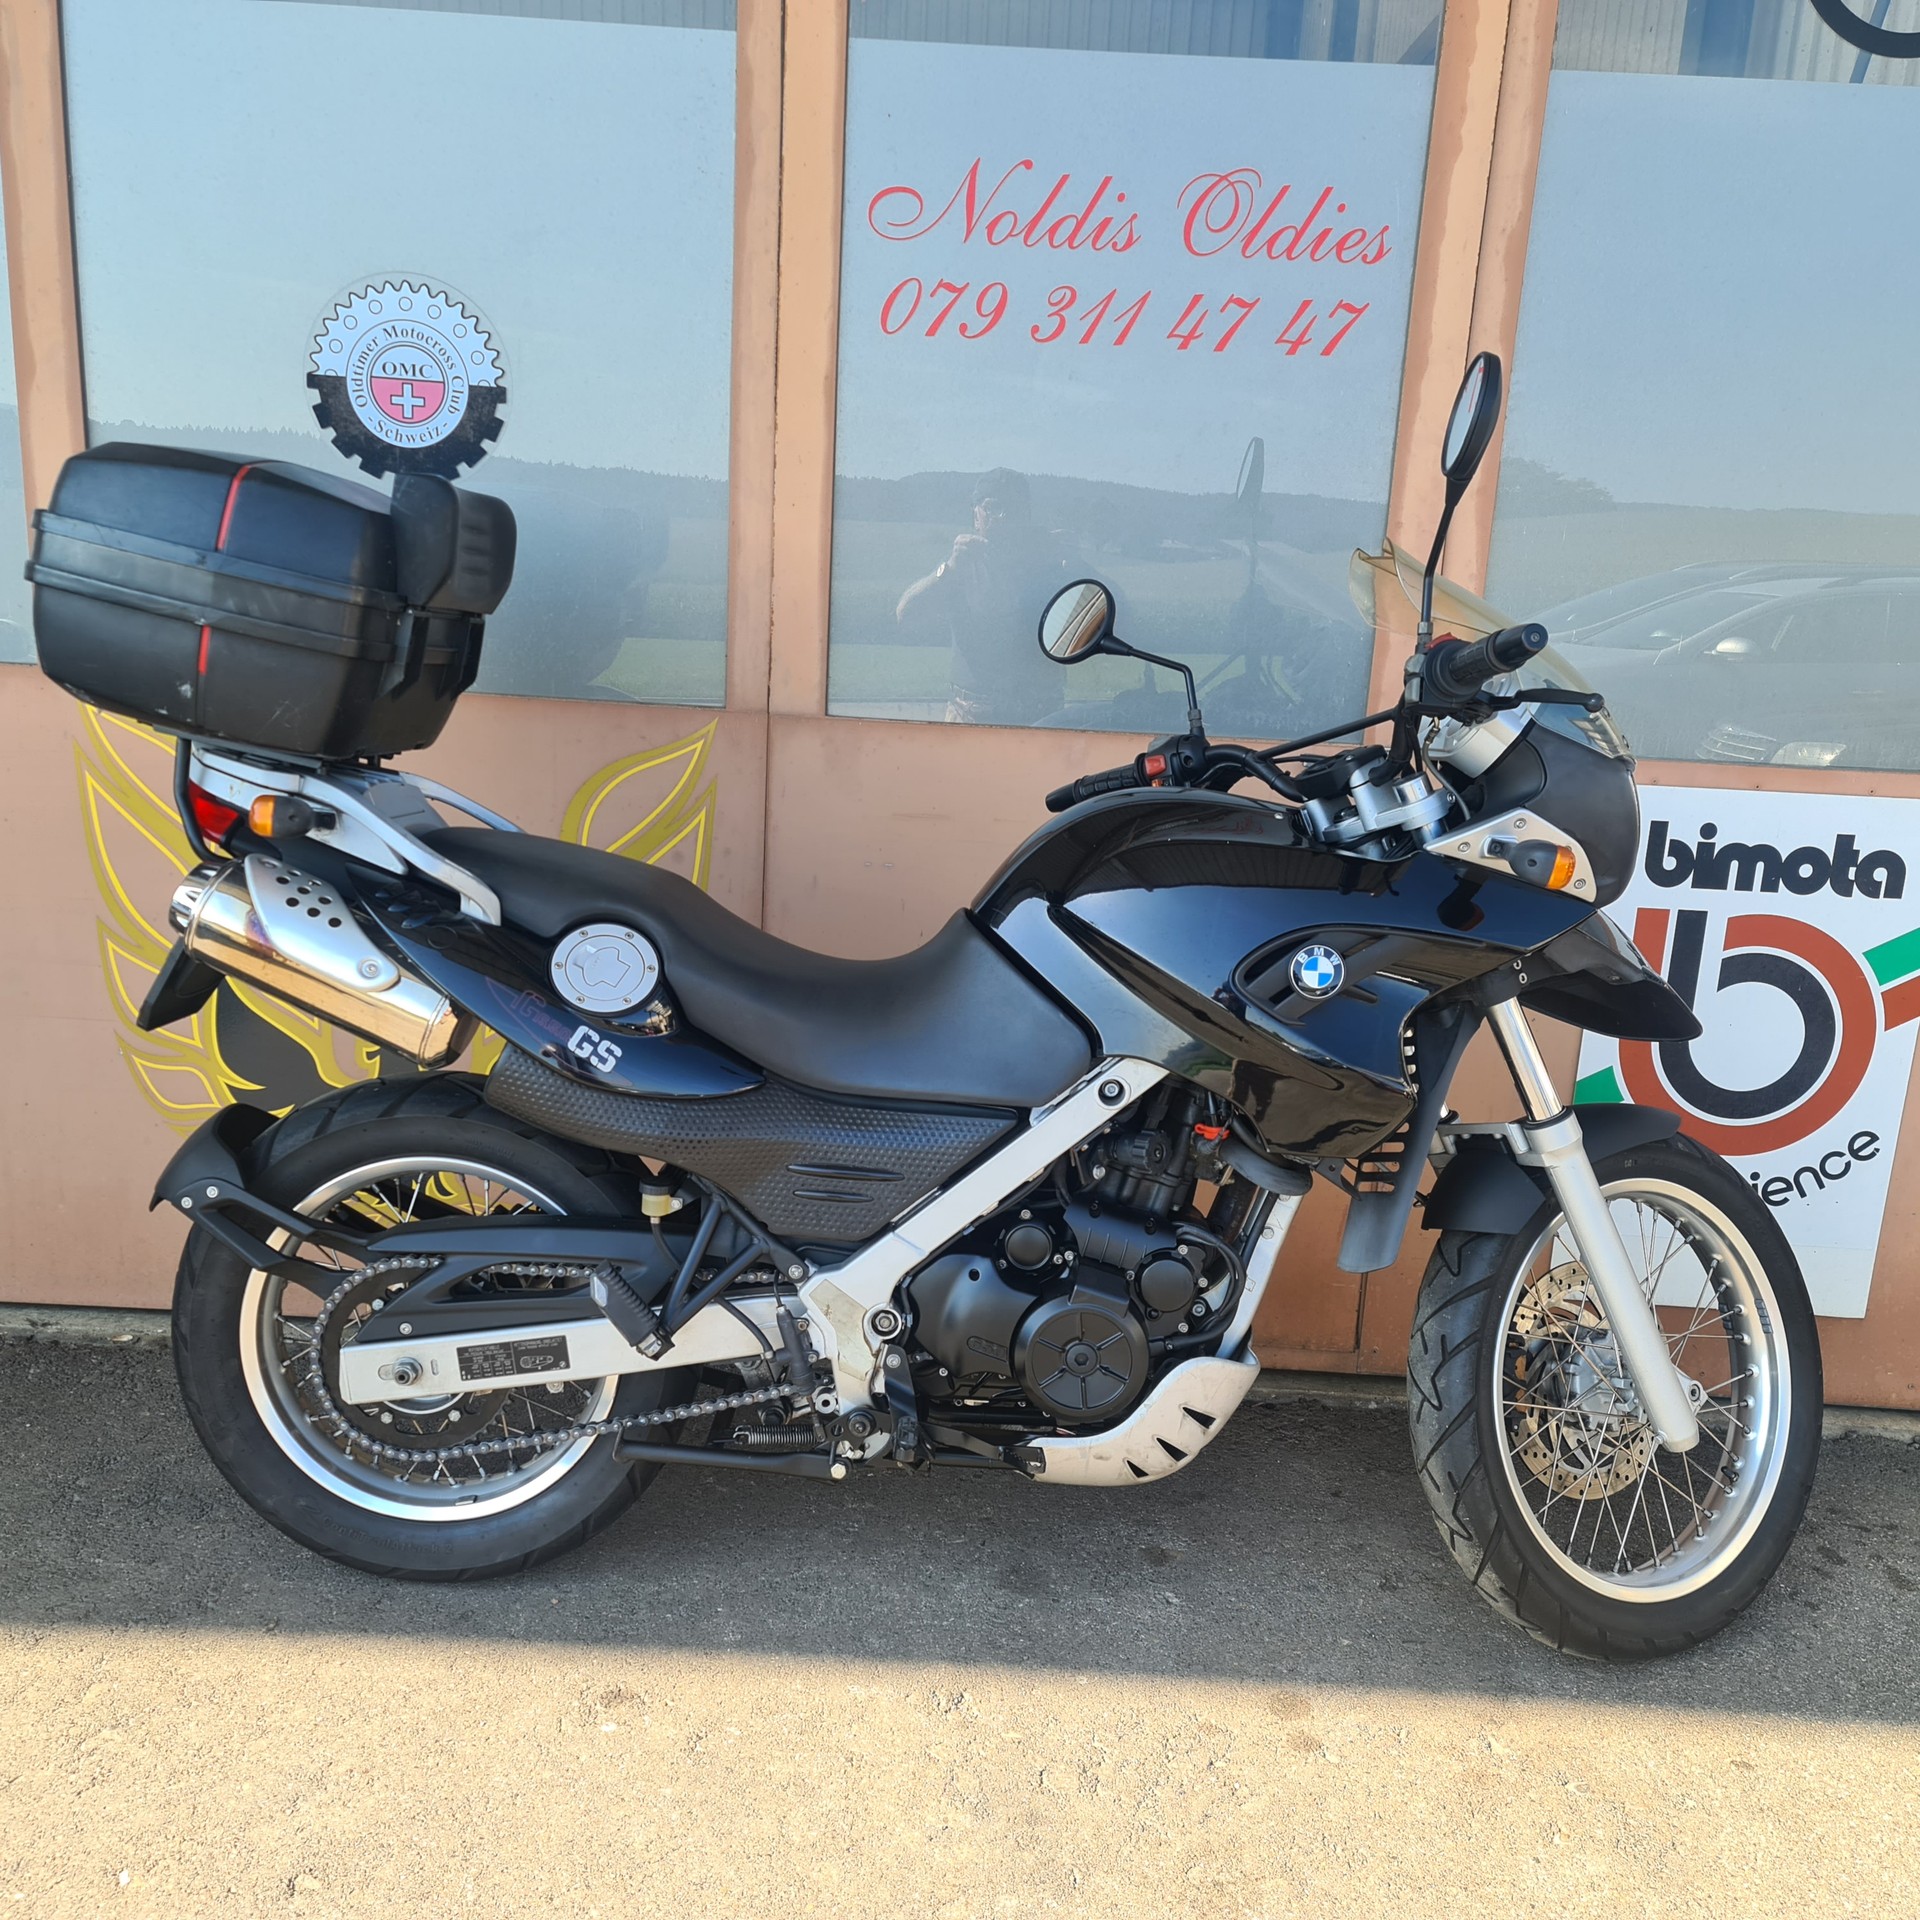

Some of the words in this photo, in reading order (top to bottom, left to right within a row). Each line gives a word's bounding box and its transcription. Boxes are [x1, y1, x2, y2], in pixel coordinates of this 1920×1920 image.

[868, 157, 1142, 252] Noldis
[1176, 167, 1393, 265] Oldies
[880, 277, 1009, 340] 079
[1030, 285, 1152, 346] 311
[1166, 293, 1261, 353] 47
[1275, 299, 1371, 357] 47
[350, 335, 379, 408] Oldtimer
[382, 325, 457, 370] Motocross
[448, 375, 465, 415] Club
[381, 361, 433, 379] OMC
[1644, 820, 1907, 900] bimota
[1296, 947, 1341, 966] BMW
[567, 1025, 623, 1073] GS
